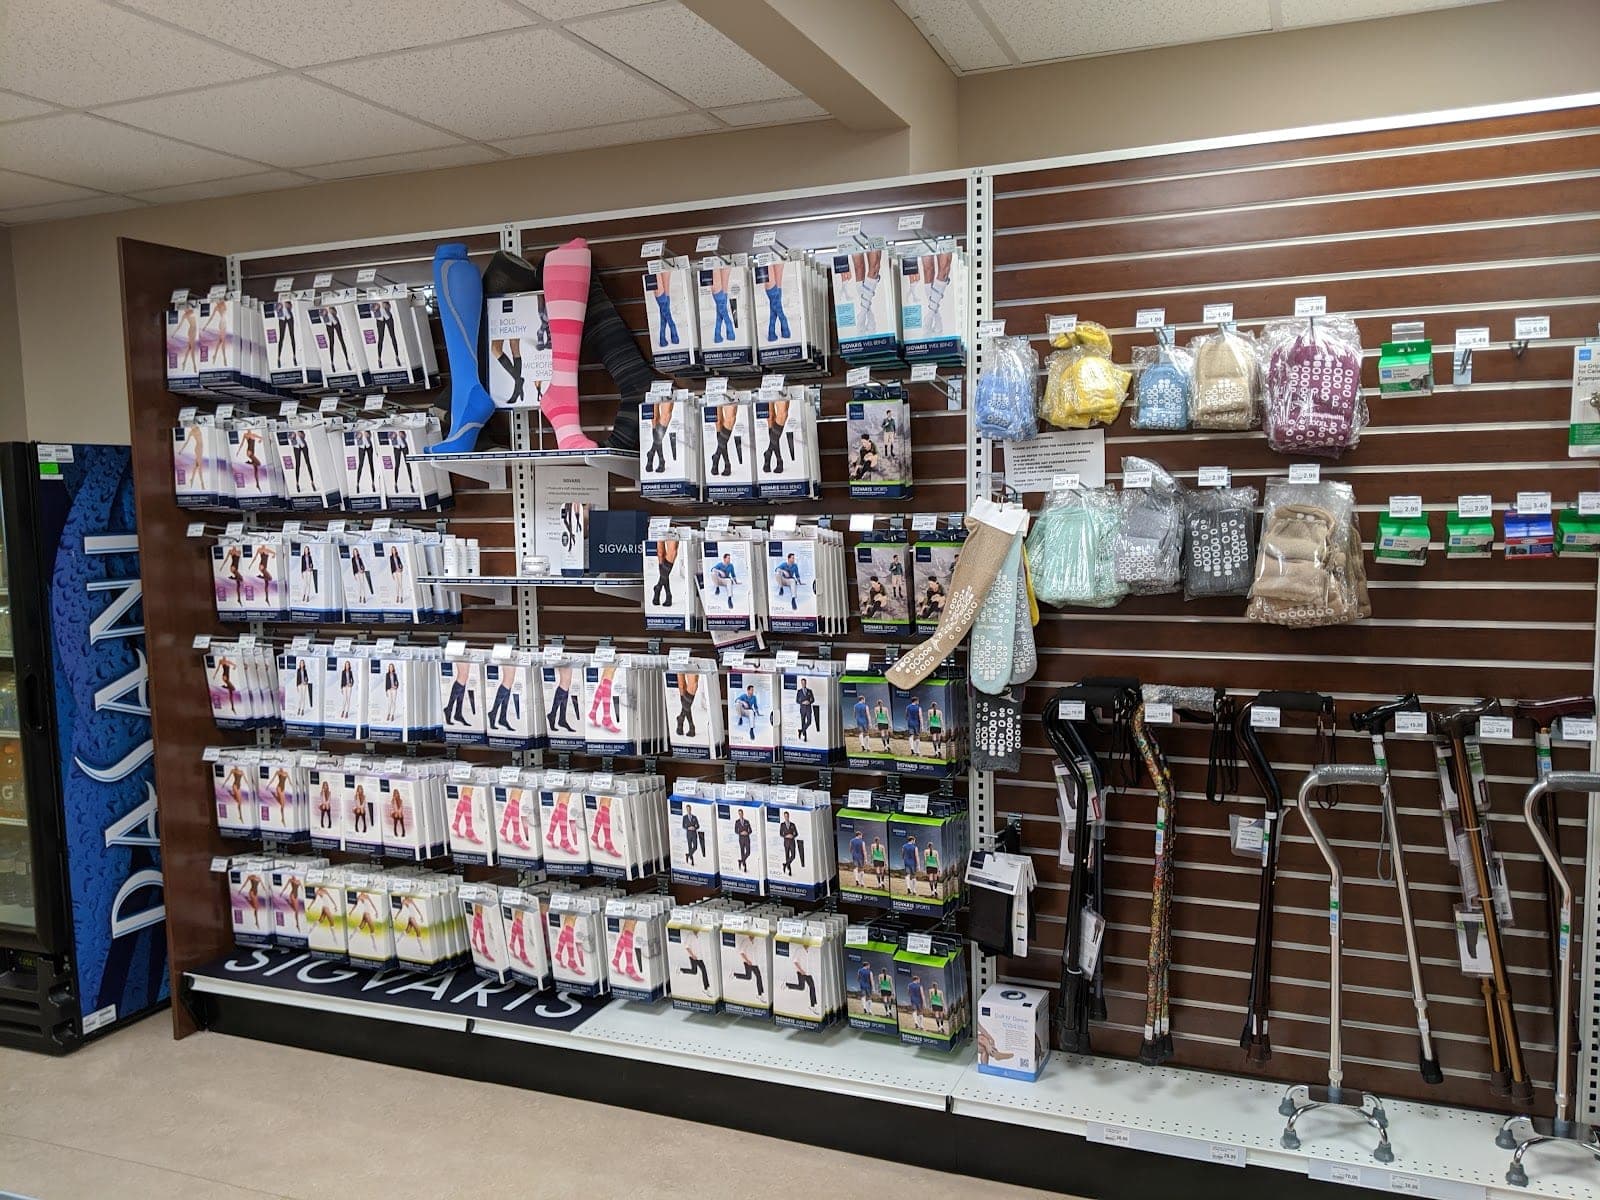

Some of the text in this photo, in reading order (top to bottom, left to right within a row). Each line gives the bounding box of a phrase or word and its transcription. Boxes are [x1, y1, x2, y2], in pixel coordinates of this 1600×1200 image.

[598, 544, 643, 554] SIGVARIS
[75, 535, 166, 940] DASANI
[223, 948, 584, 1018] SIGVARIS
